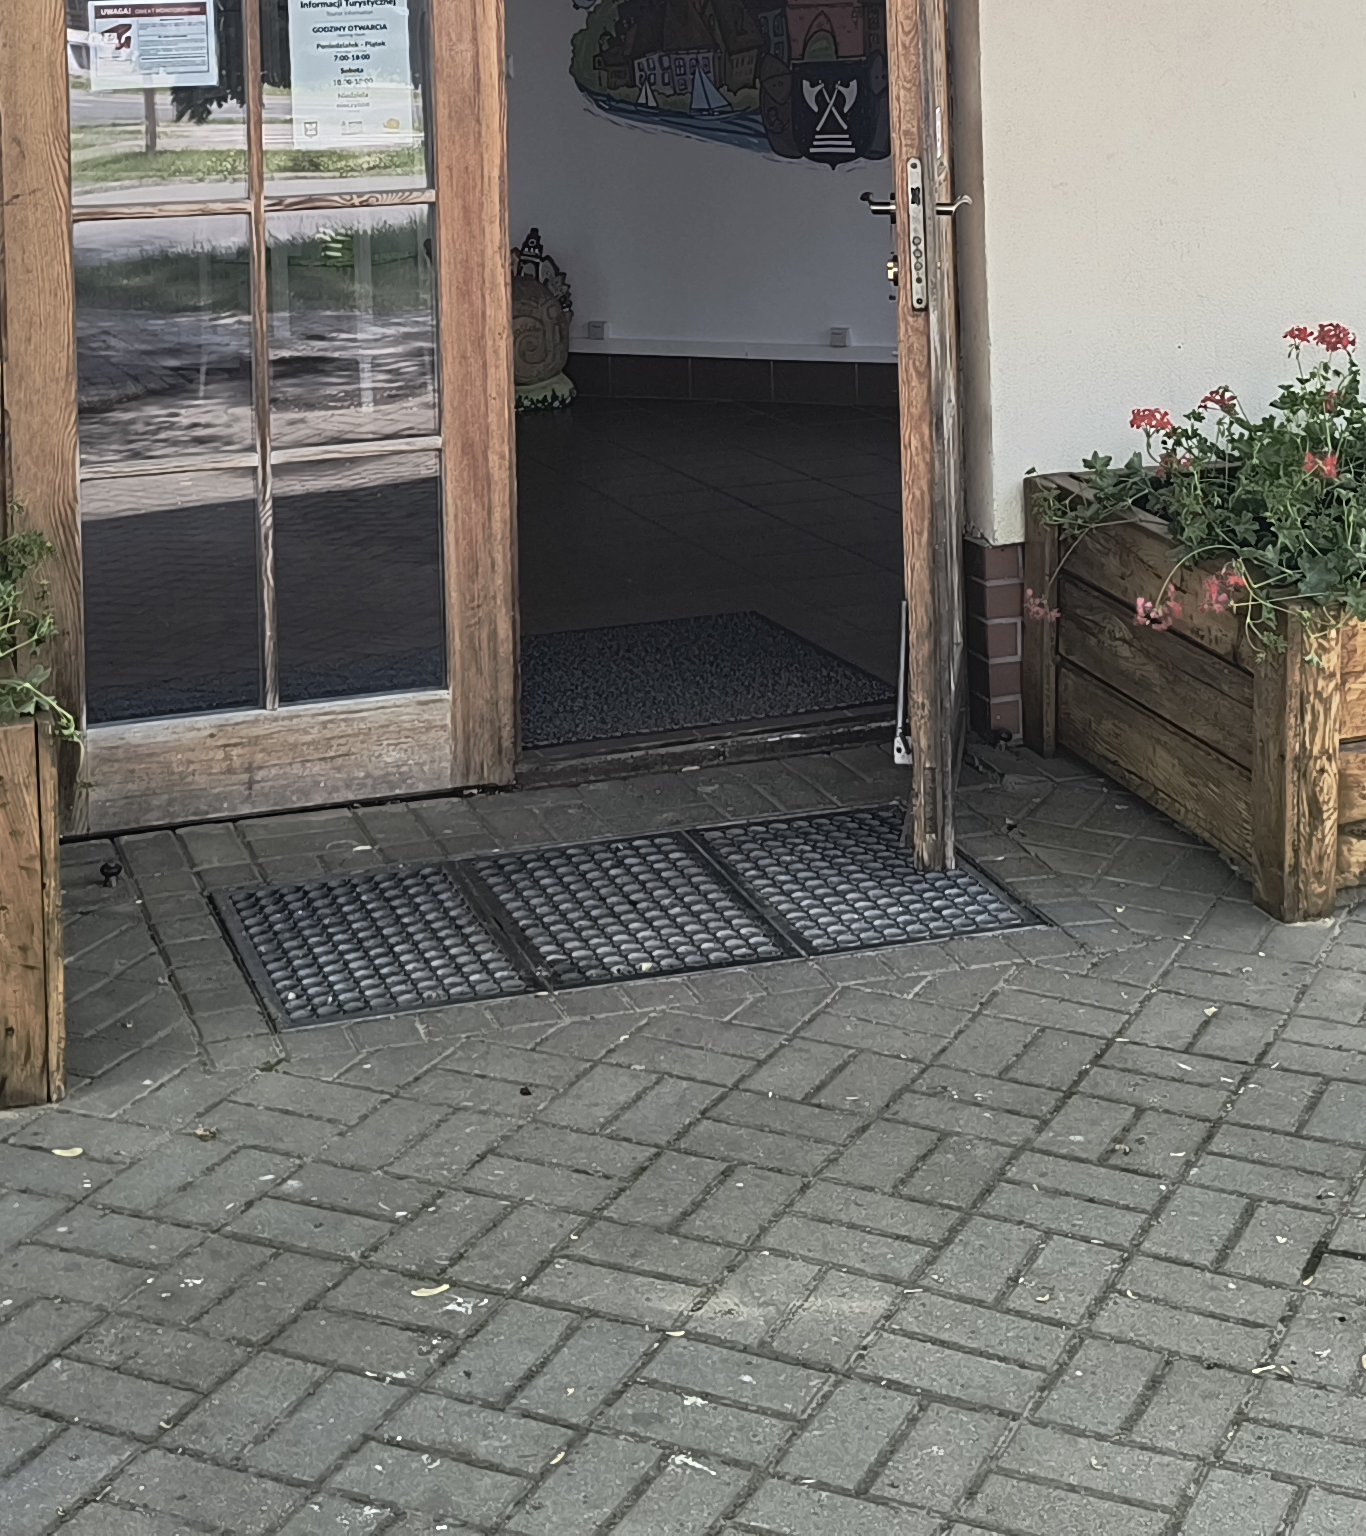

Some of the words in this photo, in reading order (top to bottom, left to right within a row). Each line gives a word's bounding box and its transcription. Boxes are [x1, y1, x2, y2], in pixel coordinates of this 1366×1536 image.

[300, 0, 342, 9] Informacji
[312, 25, 346, 33] GODZINY
[348, 24, 387, 32] OTWARCIA
